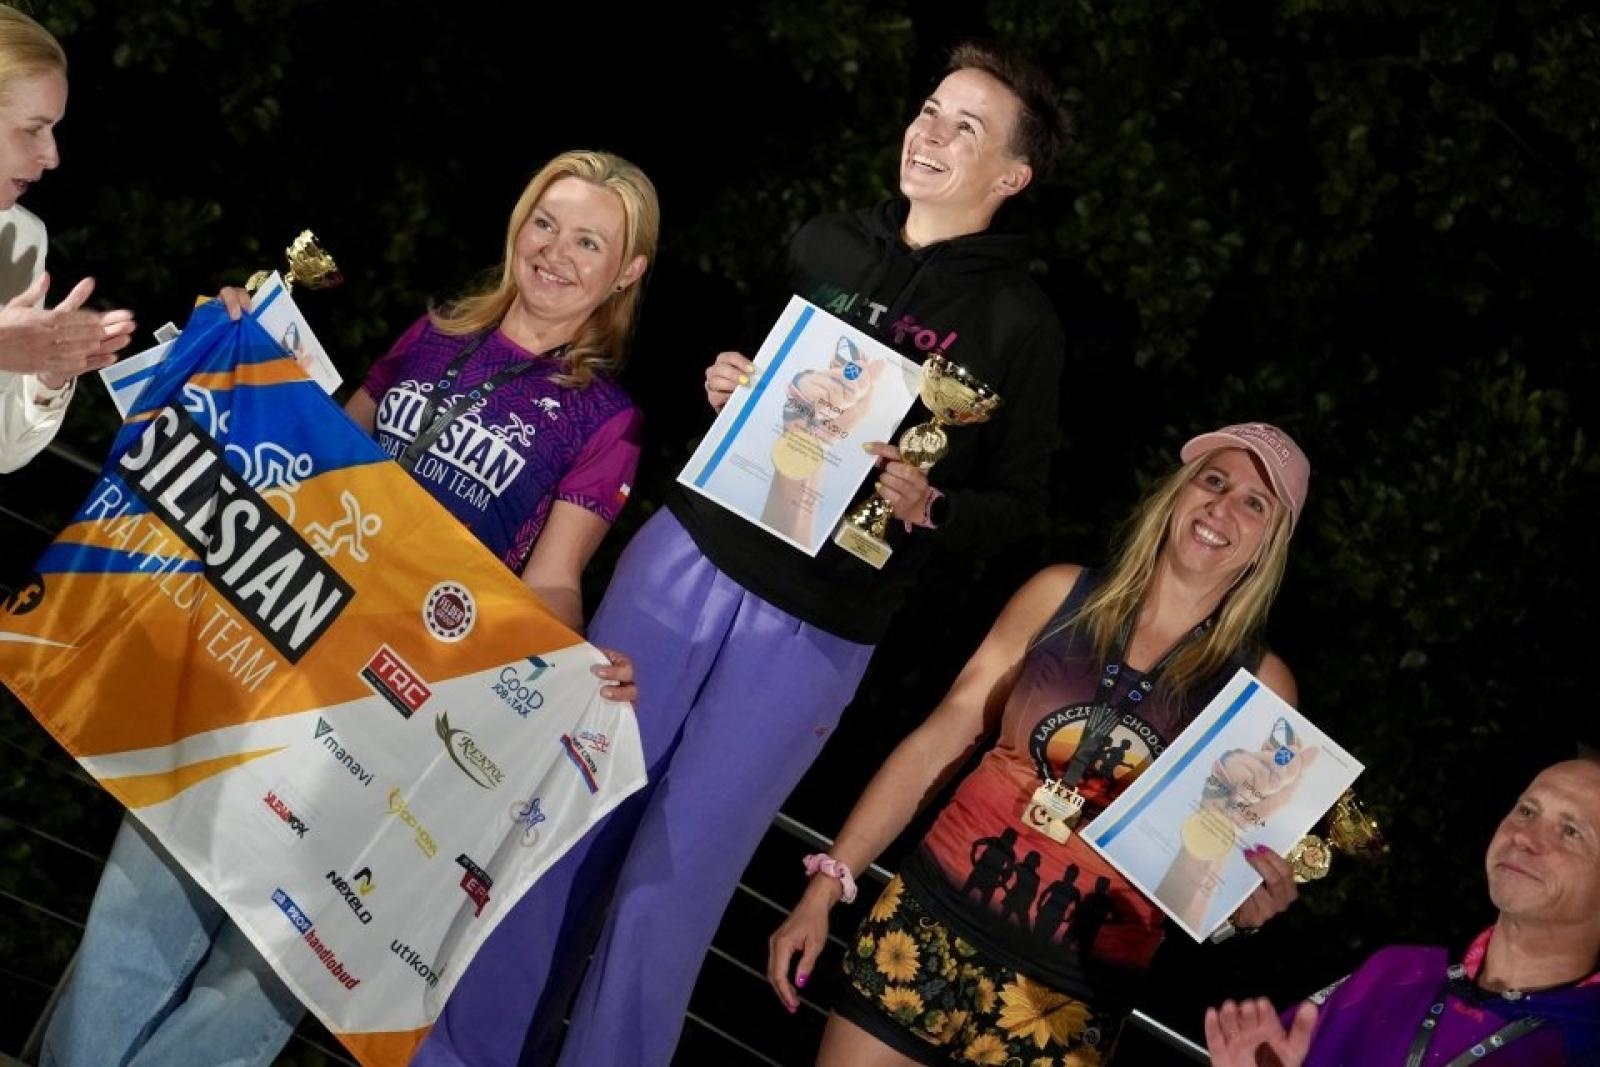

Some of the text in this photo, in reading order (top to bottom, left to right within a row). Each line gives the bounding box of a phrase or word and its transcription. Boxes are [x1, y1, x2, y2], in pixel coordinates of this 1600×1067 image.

[379, 390, 518, 491] SILSIAN
[119, 405, 344, 650] SILESIAN
[450, 463, 491, 512] TEAM
[199, 602, 278, 693] TEAM
[323, 736, 375, 787] manavi
